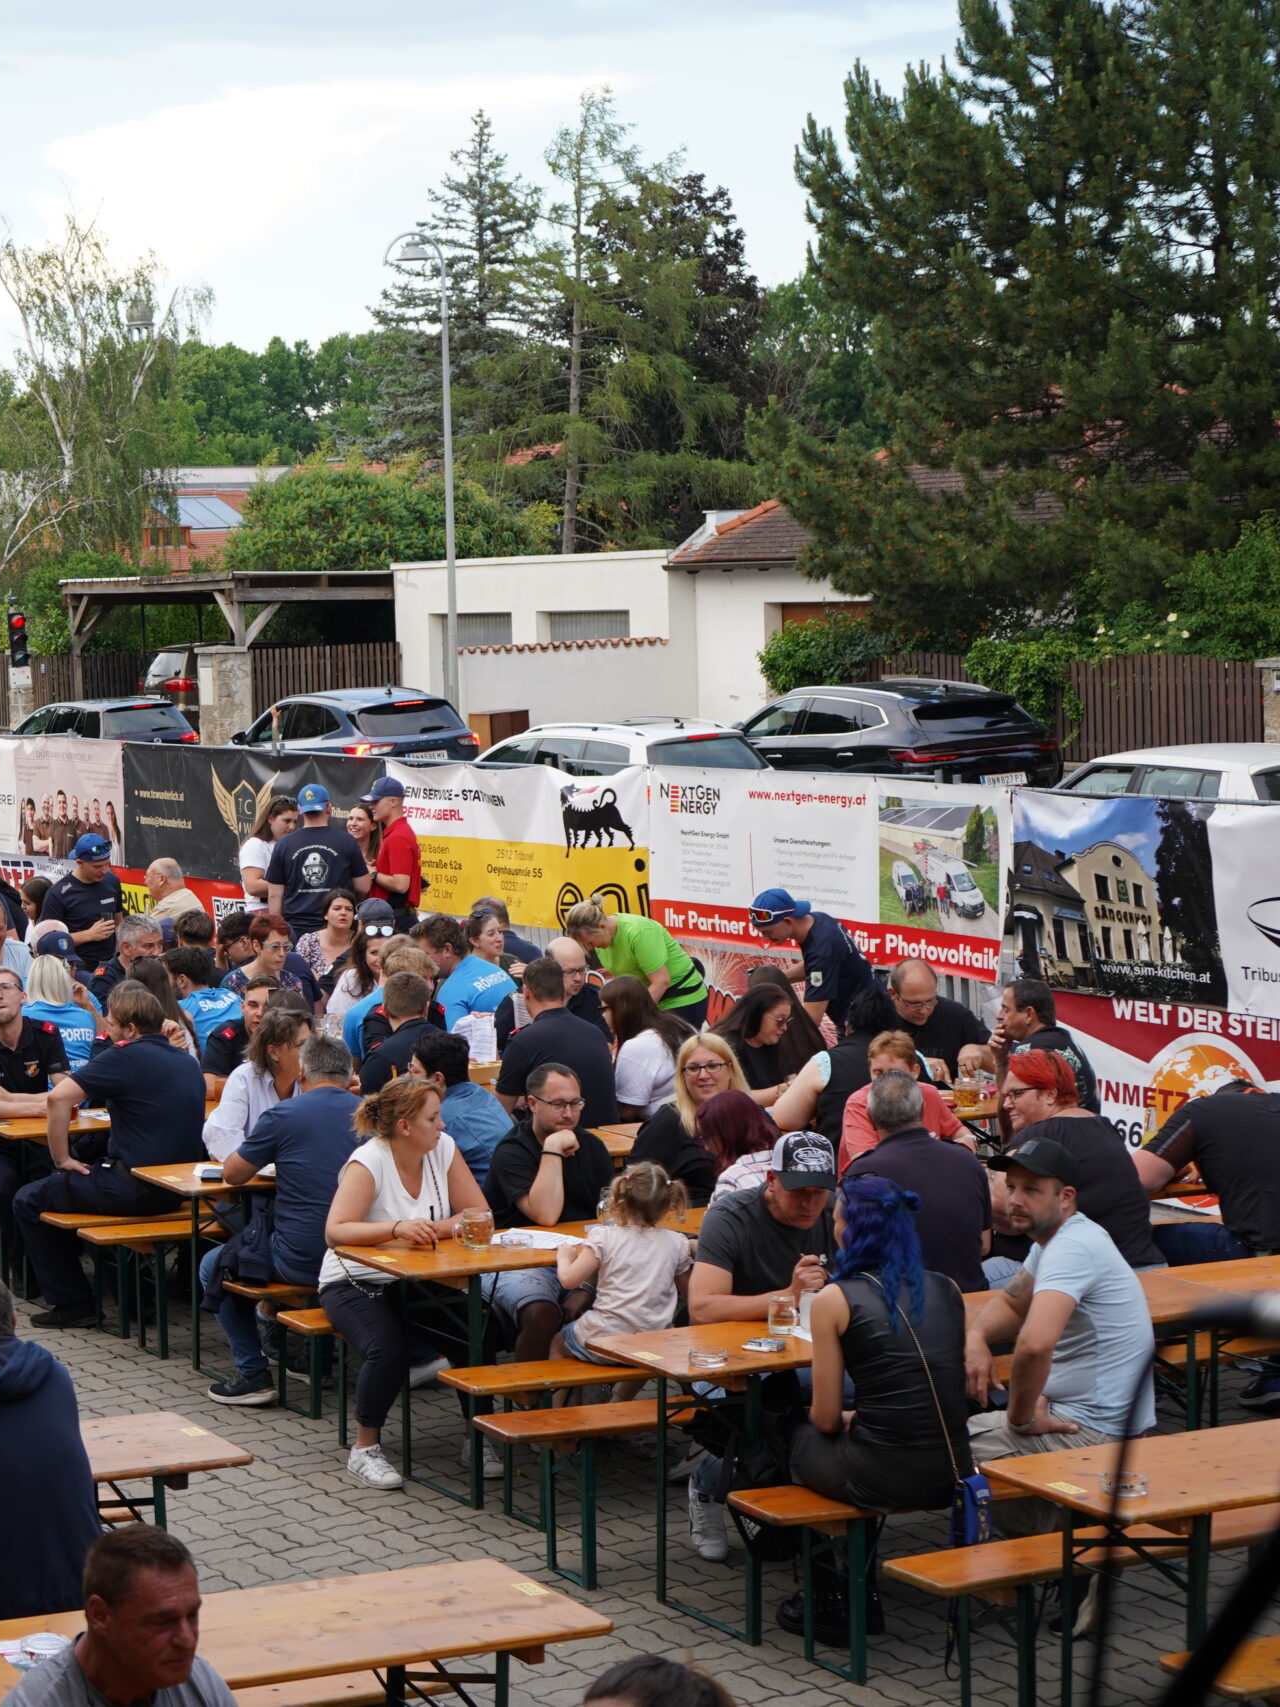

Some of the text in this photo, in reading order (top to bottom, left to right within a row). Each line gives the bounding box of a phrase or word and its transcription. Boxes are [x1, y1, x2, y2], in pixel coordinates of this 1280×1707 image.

[405, 786, 421, 798] ENI
[422, 787, 453, 801] SERVICE
[748, 790, 867, 808] www.nextgen-energy.at
[402, 806, 464, 821] PETRA ABERL
[670, 799, 718, 815] ENERGY
[428, 843, 450, 855] Baden
[496, 848, 513, 860] 2512
[421, 859, 462, 871] erstraße 62a
[444, 875, 458, 885] 949
[532, 868, 543, 879] 55
[664, 907, 746, 936] Ihr Partner
[854, 929, 882, 953] für
[1100, 963, 1211, 984] www.sim-kitchen.at
[1240, 965, 1280, 983] Tribu
[1112, 997, 1280, 1041] WELT DER STEI
[60, 1027, 95, 1042] PORTER
